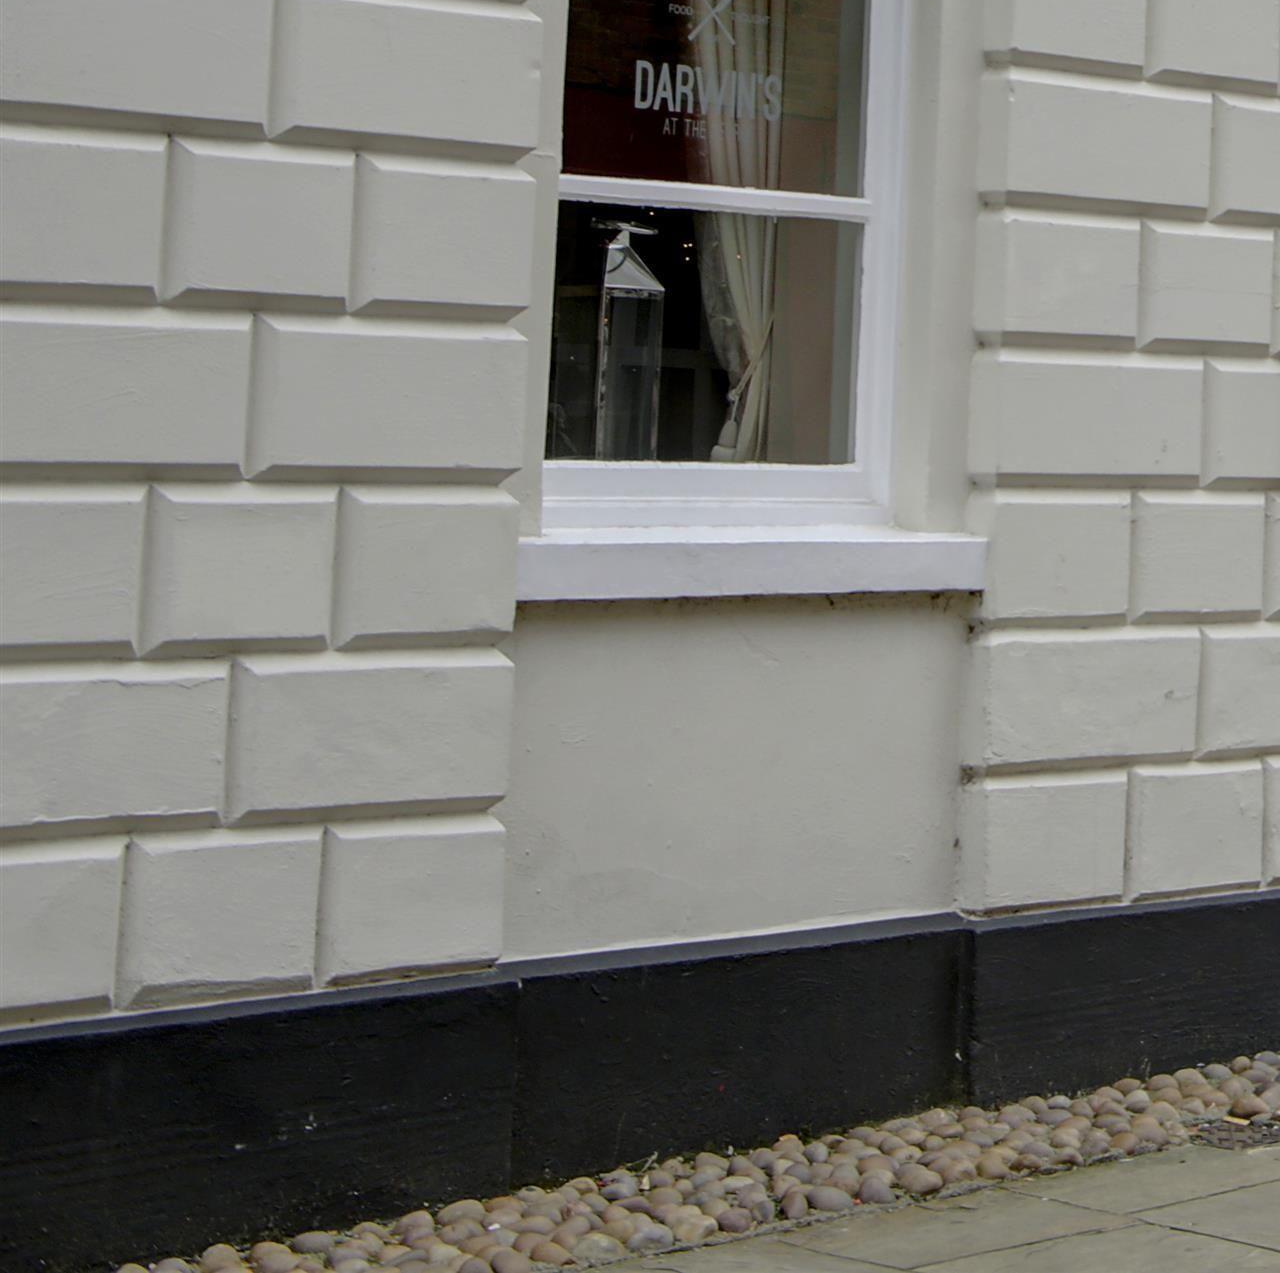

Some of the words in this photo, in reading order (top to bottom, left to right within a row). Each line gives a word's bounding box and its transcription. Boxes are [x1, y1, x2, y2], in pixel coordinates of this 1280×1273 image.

[668, 3, 694, 16] FOOD
[634, 59, 782, 122] DARWIN'S
[663, 117, 677, 136] AT
[684, 119, 706, 140] THE
